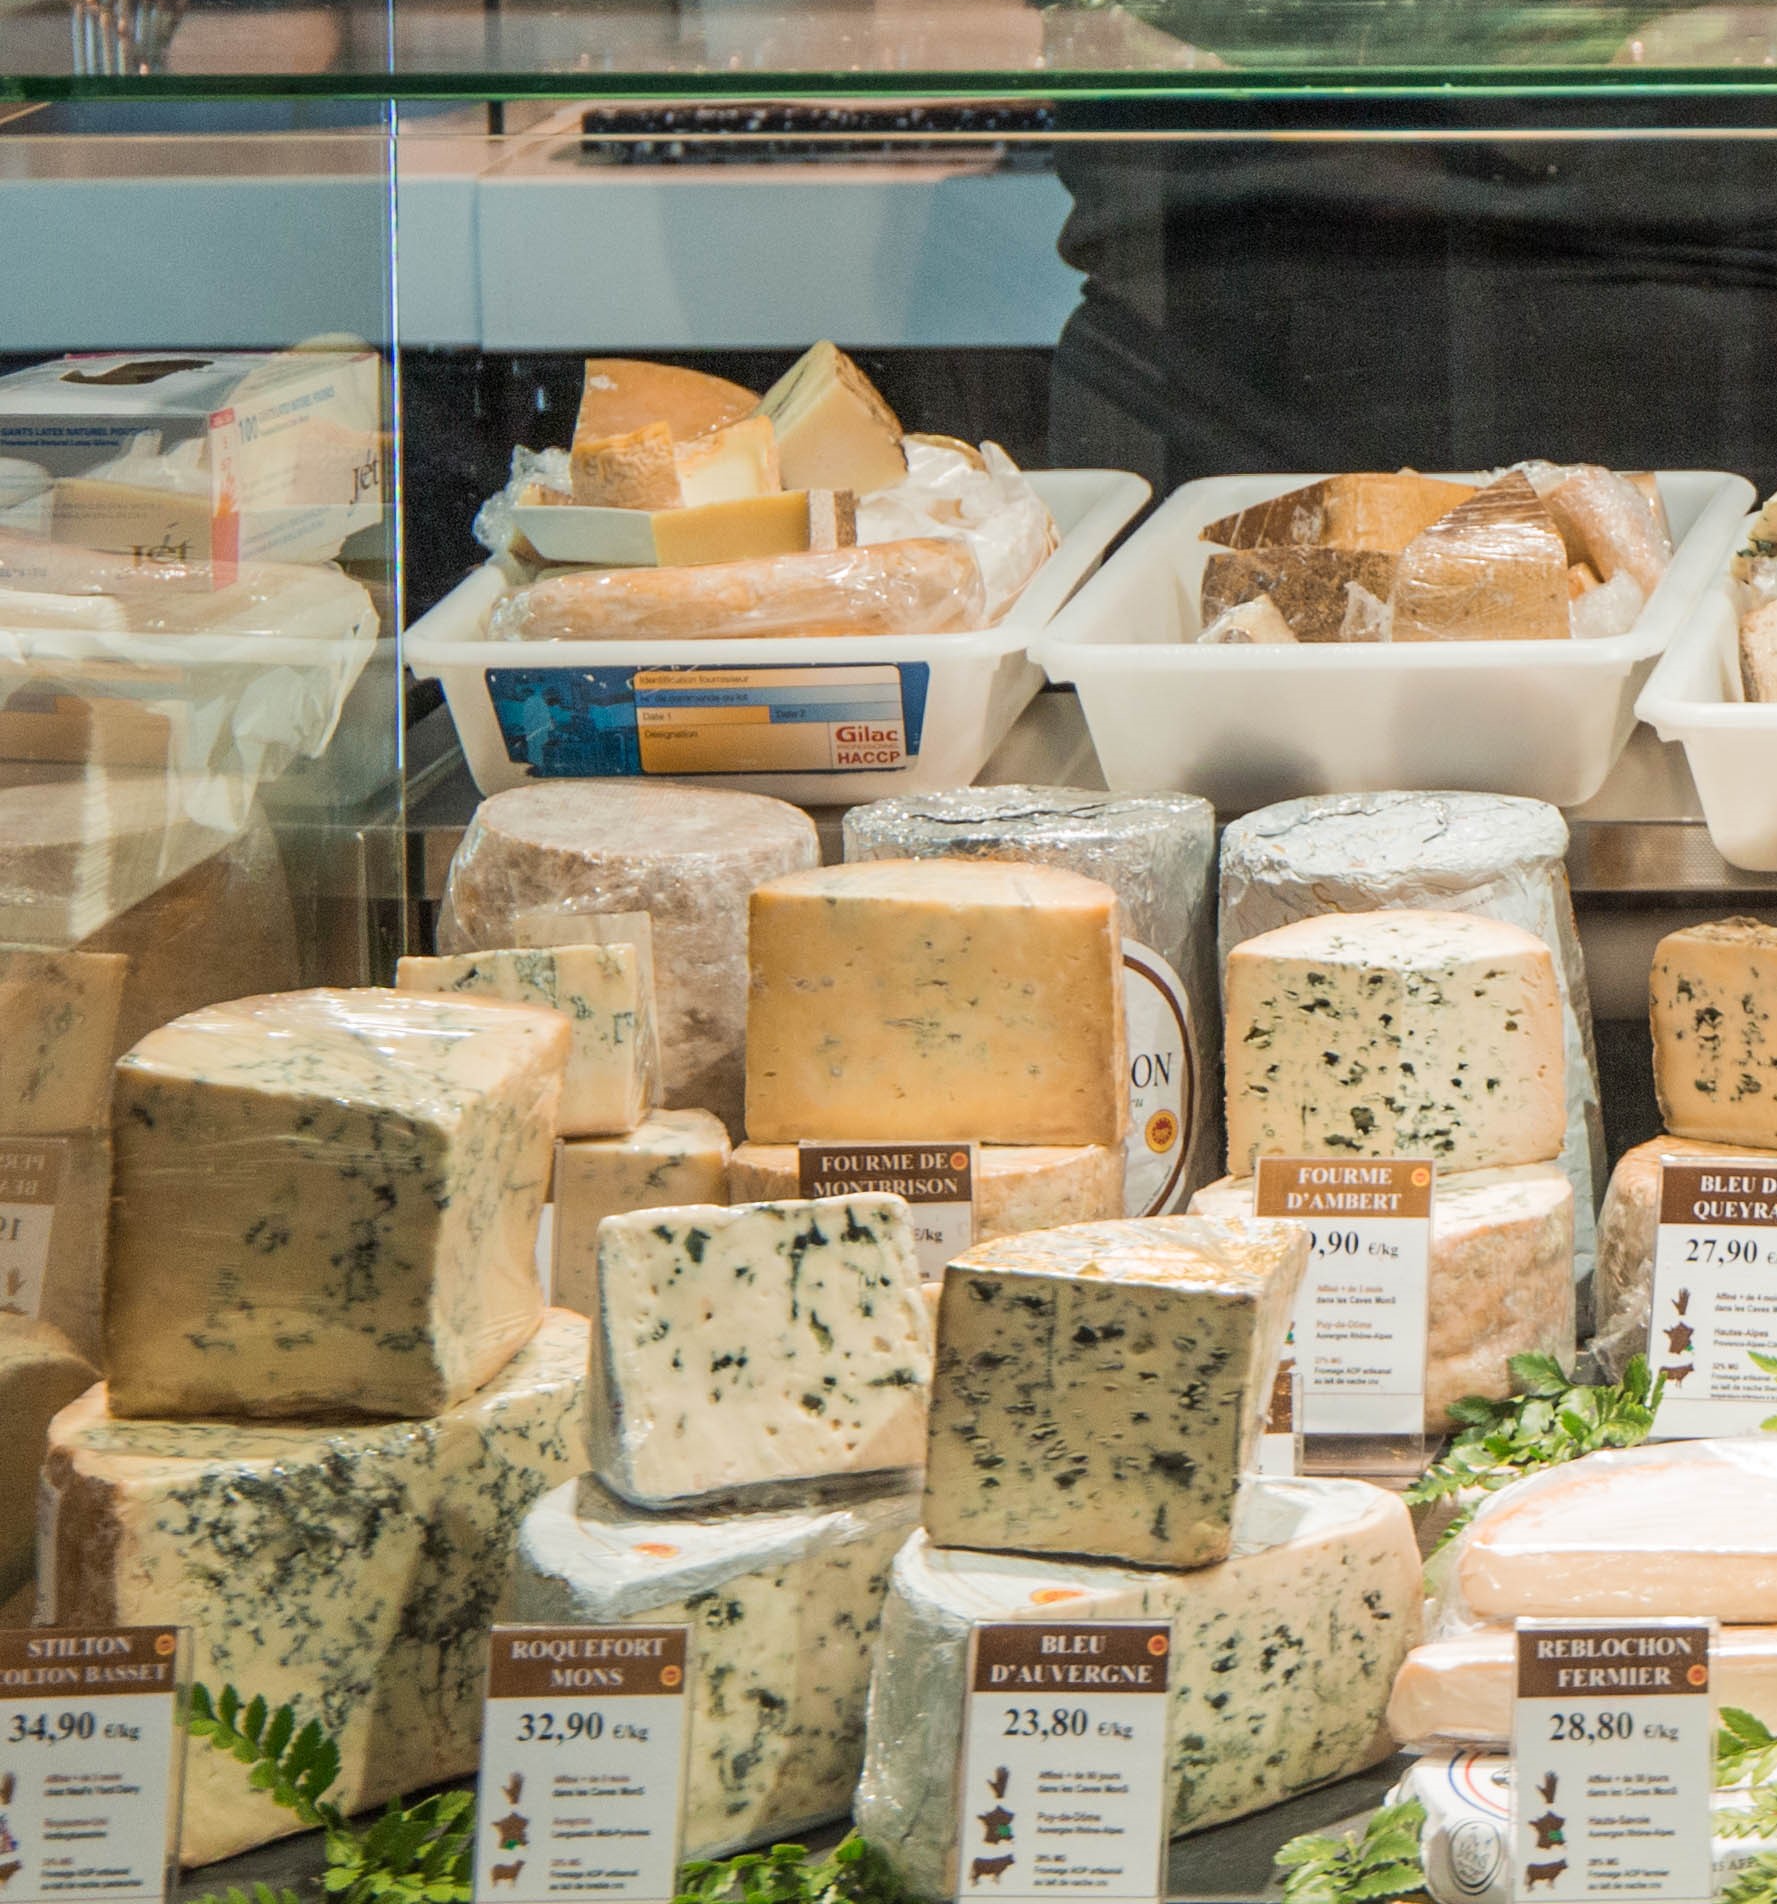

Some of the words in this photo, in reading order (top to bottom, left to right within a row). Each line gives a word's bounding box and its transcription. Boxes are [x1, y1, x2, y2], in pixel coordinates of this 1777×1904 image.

[643, 711, 663, 720] Date
[835, 725, 898, 743] Gilac
[837, 750, 900, 764] HACCP
[1131, 1052, 1172, 1088] ON
[822, 1153, 914, 1172] FOURME
[921, 1152, 948, 1169] DE
[1298, 1167, 1392, 1185] FOURME
[1701, 1176, 1756, 1193] BLEU
[814, 1178, 958, 1197] MONTBRISON
[1368, 1243, 1398, 1258] €/kg
[1686, 1239, 1758, 1267] 27,90
[27, 1635, 131, 1658] STILTON
[511, 1637, 667, 1663] ROQUEFORT
[1041, 1635, 1107, 1654] BLEU
[1537, 1636, 1693, 1659] REBLOCHON
[550, 1668, 624, 1688] MONS
[1558, 1667, 1673, 1688] FERMIER
[8, 1712, 97, 1746] 34,90
[104, 1722, 141, 1741] €/kg
[517, 1712, 604, 1746] 32,90
[613, 1724, 649, 1742] €/kg
[1003, 1708, 1088, 1742] 23,80
[1097, 1722, 1133, 1739] €/kg
[1549, 1712, 1634, 1745] 28,80
[1643, 1724, 1679, 1741] €/kg
